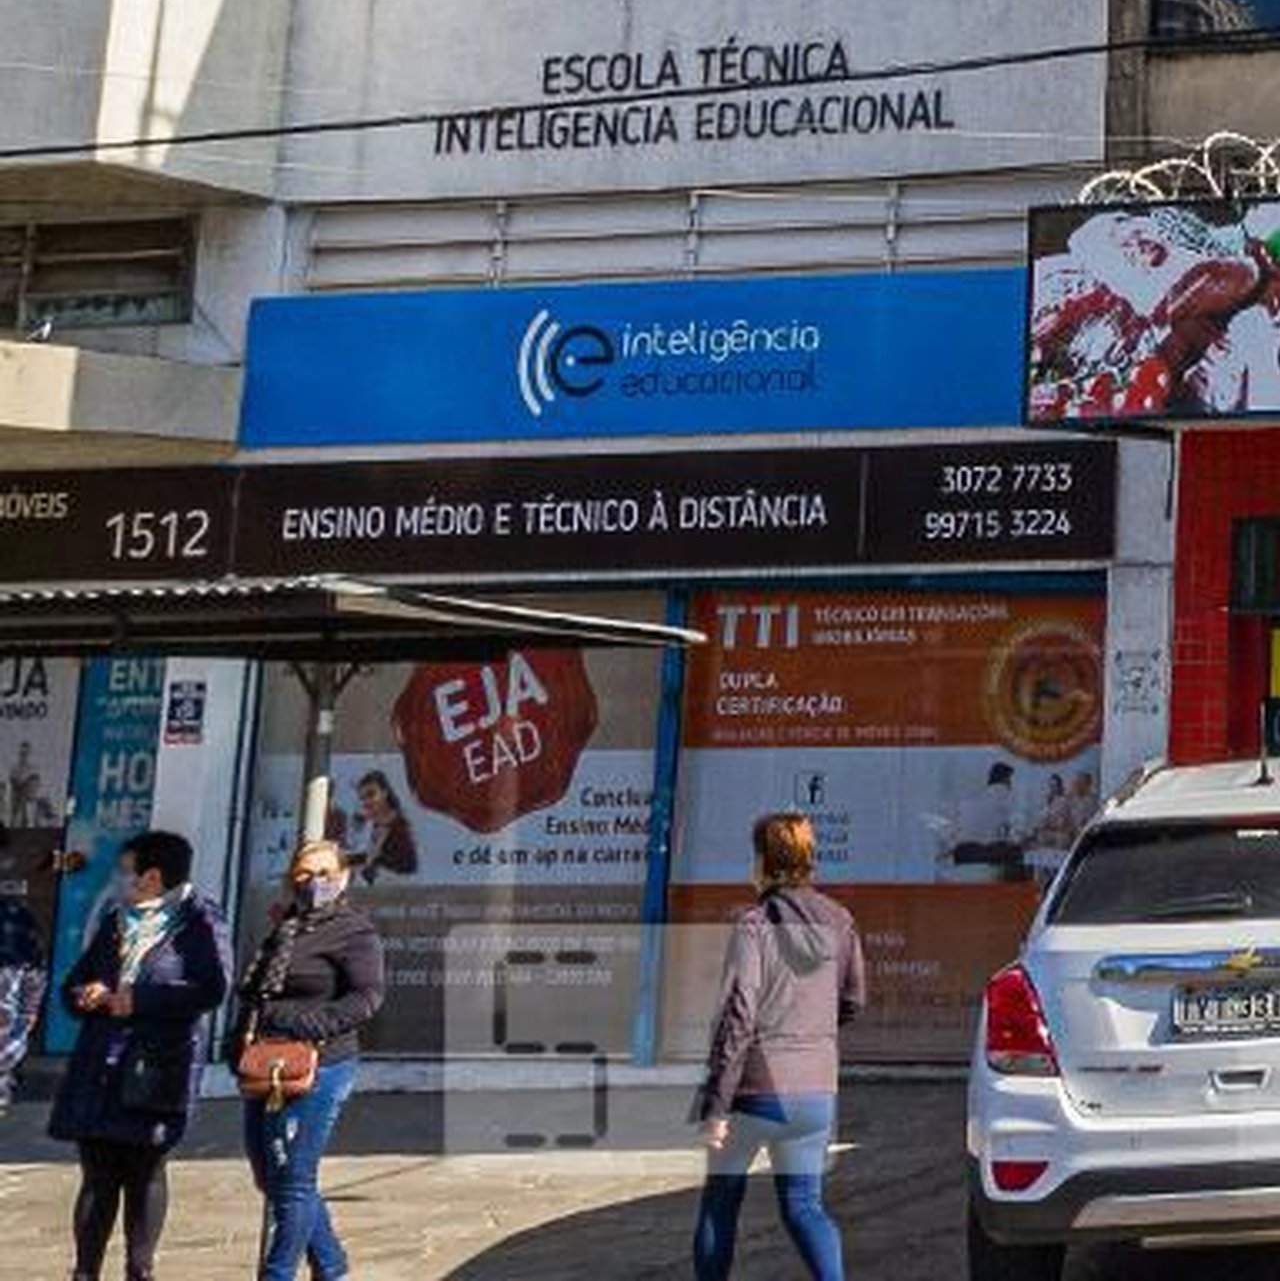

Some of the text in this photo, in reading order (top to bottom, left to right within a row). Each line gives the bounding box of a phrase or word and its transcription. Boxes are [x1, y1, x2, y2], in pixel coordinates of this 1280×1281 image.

[542, 38, 850, 95] ESCOLA TÉCNICA
[695, 90, 954, 141] EDUCACIONAL
[621, 319, 820, 363] inteligência
[942, 463, 1073, 493] 3072 7733
[0, 486, 69, 519] ÓVEIS
[282, 488, 828, 541] ENSINO MÉDIO E TÉCNICO À DISTÂNCIA
[925, 510, 1001, 539] 99715
[105, 509, 210, 560] 1512
[717, 605, 800, 649] TTI
[433, 651, 549, 744] EJA
[716, 694, 844, 717] CERTIFICAÇÃO
[463, 720, 543, 783] EAD
